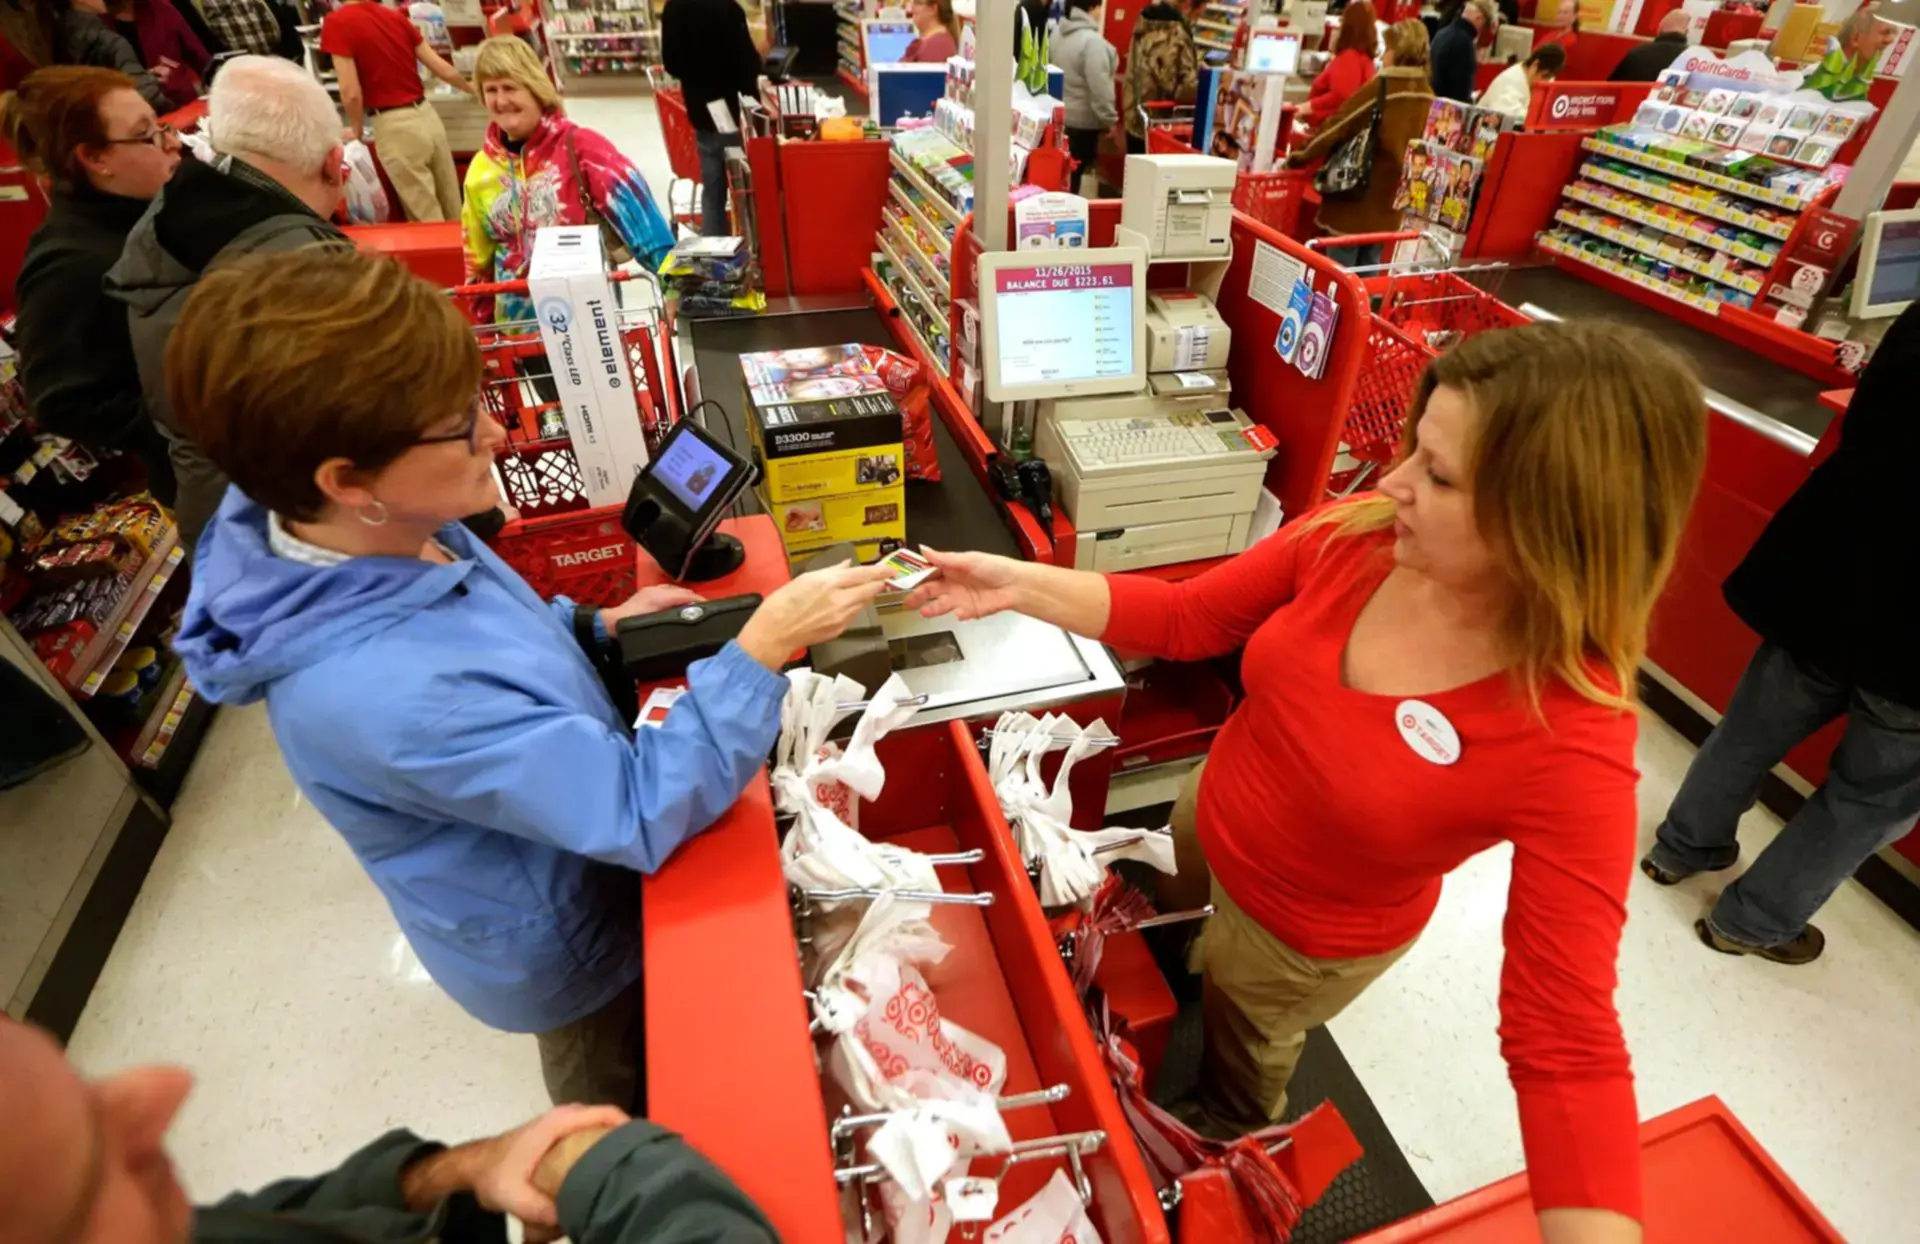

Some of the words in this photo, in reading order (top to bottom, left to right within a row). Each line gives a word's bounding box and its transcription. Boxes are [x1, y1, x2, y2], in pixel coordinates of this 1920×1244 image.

[1697, 60, 1751, 81] GiftCards
[1035, 266, 1092, 278] 11/26/2015
[1006, 277, 1047, 290] BALANCE
[1052, 278, 1069, 287] DUE
[1075, 276, 1114, 287] $223.61
[586, 299, 618, 375] element
[569, 366, 582, 386] LED
[774, 431, 810, 446] D3300
[551, 542, 625, 568] TARGET
